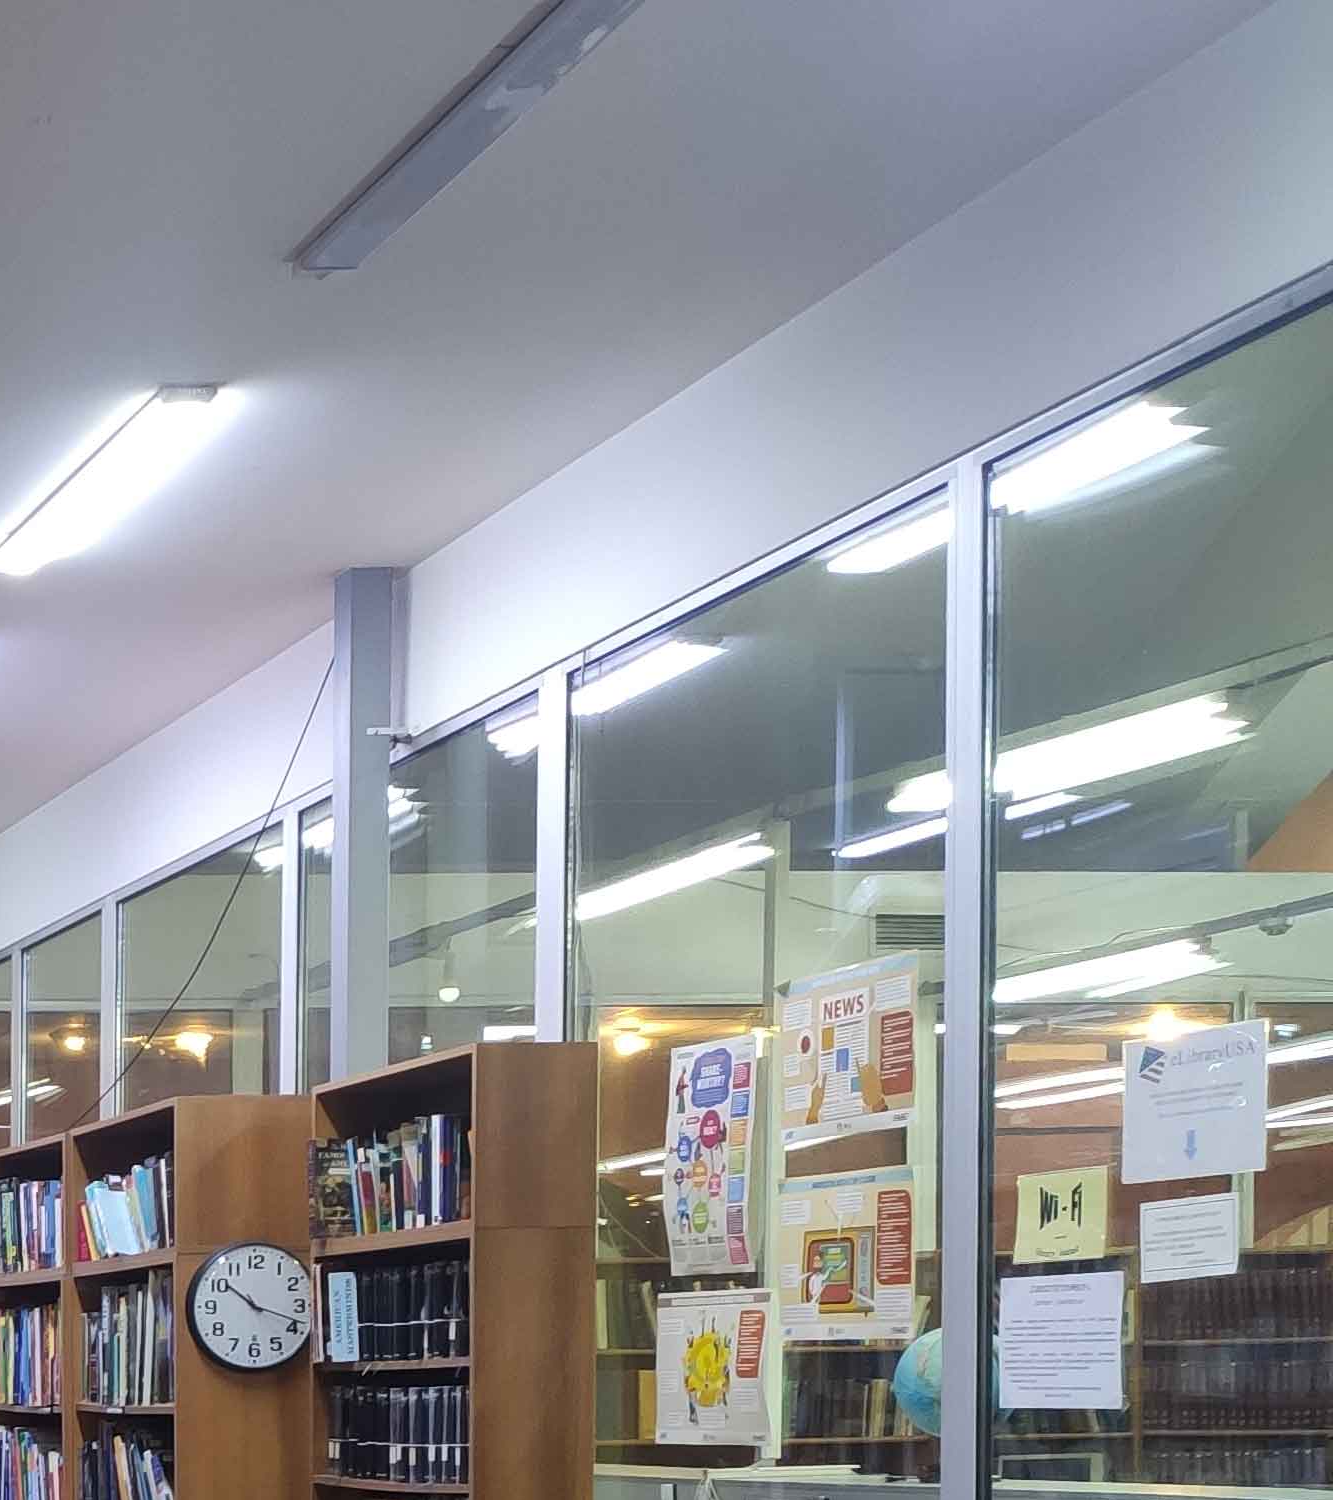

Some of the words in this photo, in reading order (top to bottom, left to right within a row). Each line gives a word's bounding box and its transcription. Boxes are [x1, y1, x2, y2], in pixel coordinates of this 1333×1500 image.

[822, 994, 864, 1021] NEWS
[228, 1262, 241, 1277] 11
[248, 1254, 266, 1270] 12
[276, 1261, 283, 1276] 1
[210, 1278, 230, 1293] 10
[286, 1276, 300, 1292] 2
[204, 1299, 217, 1315] 9
[293, 1298, 306, 1313] 3
[212, 1321, 225, 1337] 8
[285, 1319, 299, 1335] 4
[228, 1337, 241, 1353] 7
[248, 1342, 262, 1358] 6
[269, 1336, 283, 1352] 5
